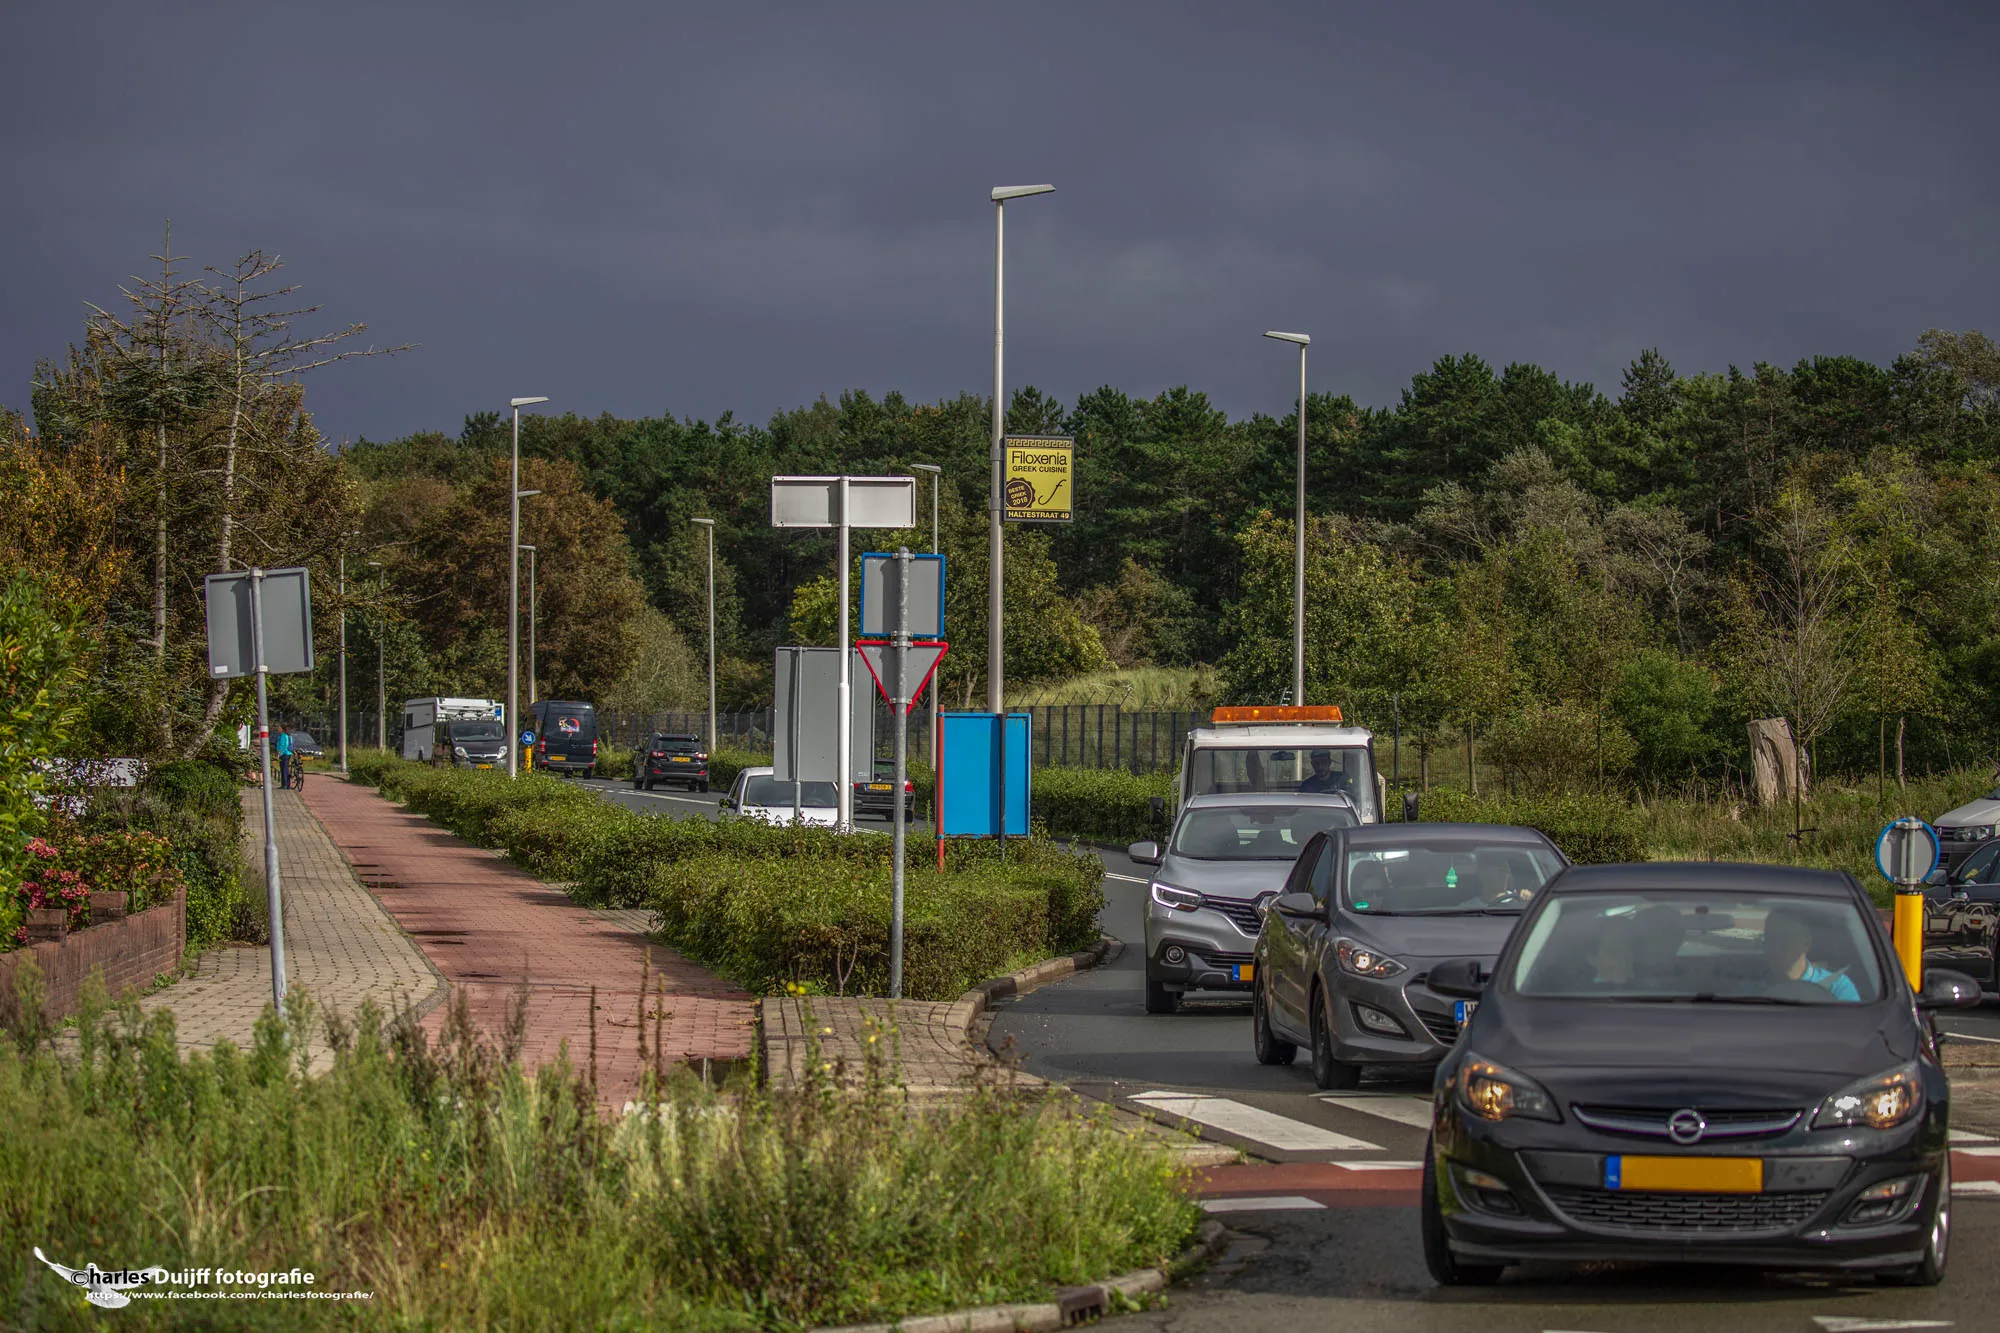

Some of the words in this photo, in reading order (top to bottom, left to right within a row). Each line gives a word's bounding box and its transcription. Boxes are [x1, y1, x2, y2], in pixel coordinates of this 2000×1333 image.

[1012, 450, 1067, 465] Filoxenia
[1008, 485, 1025, 493] BESTE
[1012, 496, 1028, 505] 2018
